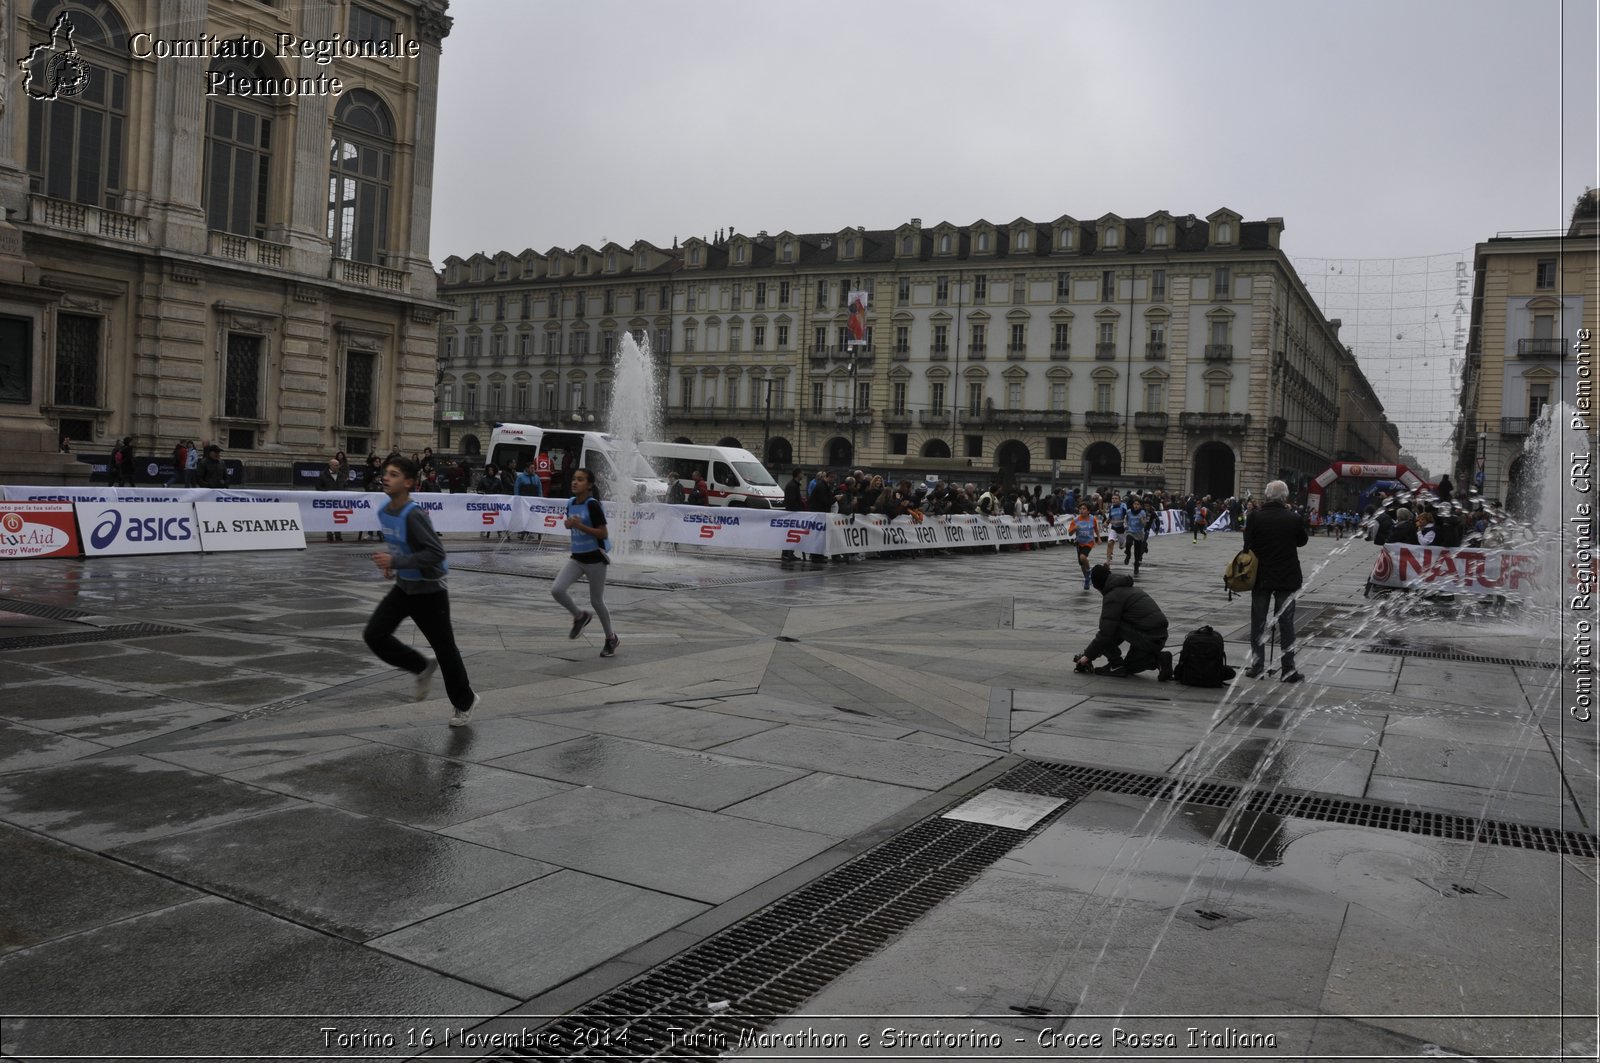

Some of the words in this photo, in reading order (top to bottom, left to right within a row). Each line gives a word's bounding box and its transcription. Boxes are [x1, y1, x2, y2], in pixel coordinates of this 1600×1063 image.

[312, 500, 371, 509] ESSELUNGA
[466, 503, 512, 512] ESSELUNGA
[683, 513, 740, 526] ESSELUNGA
[203, 520, 228, 533] LA
[232, 519, 300, 532] STAMPA
